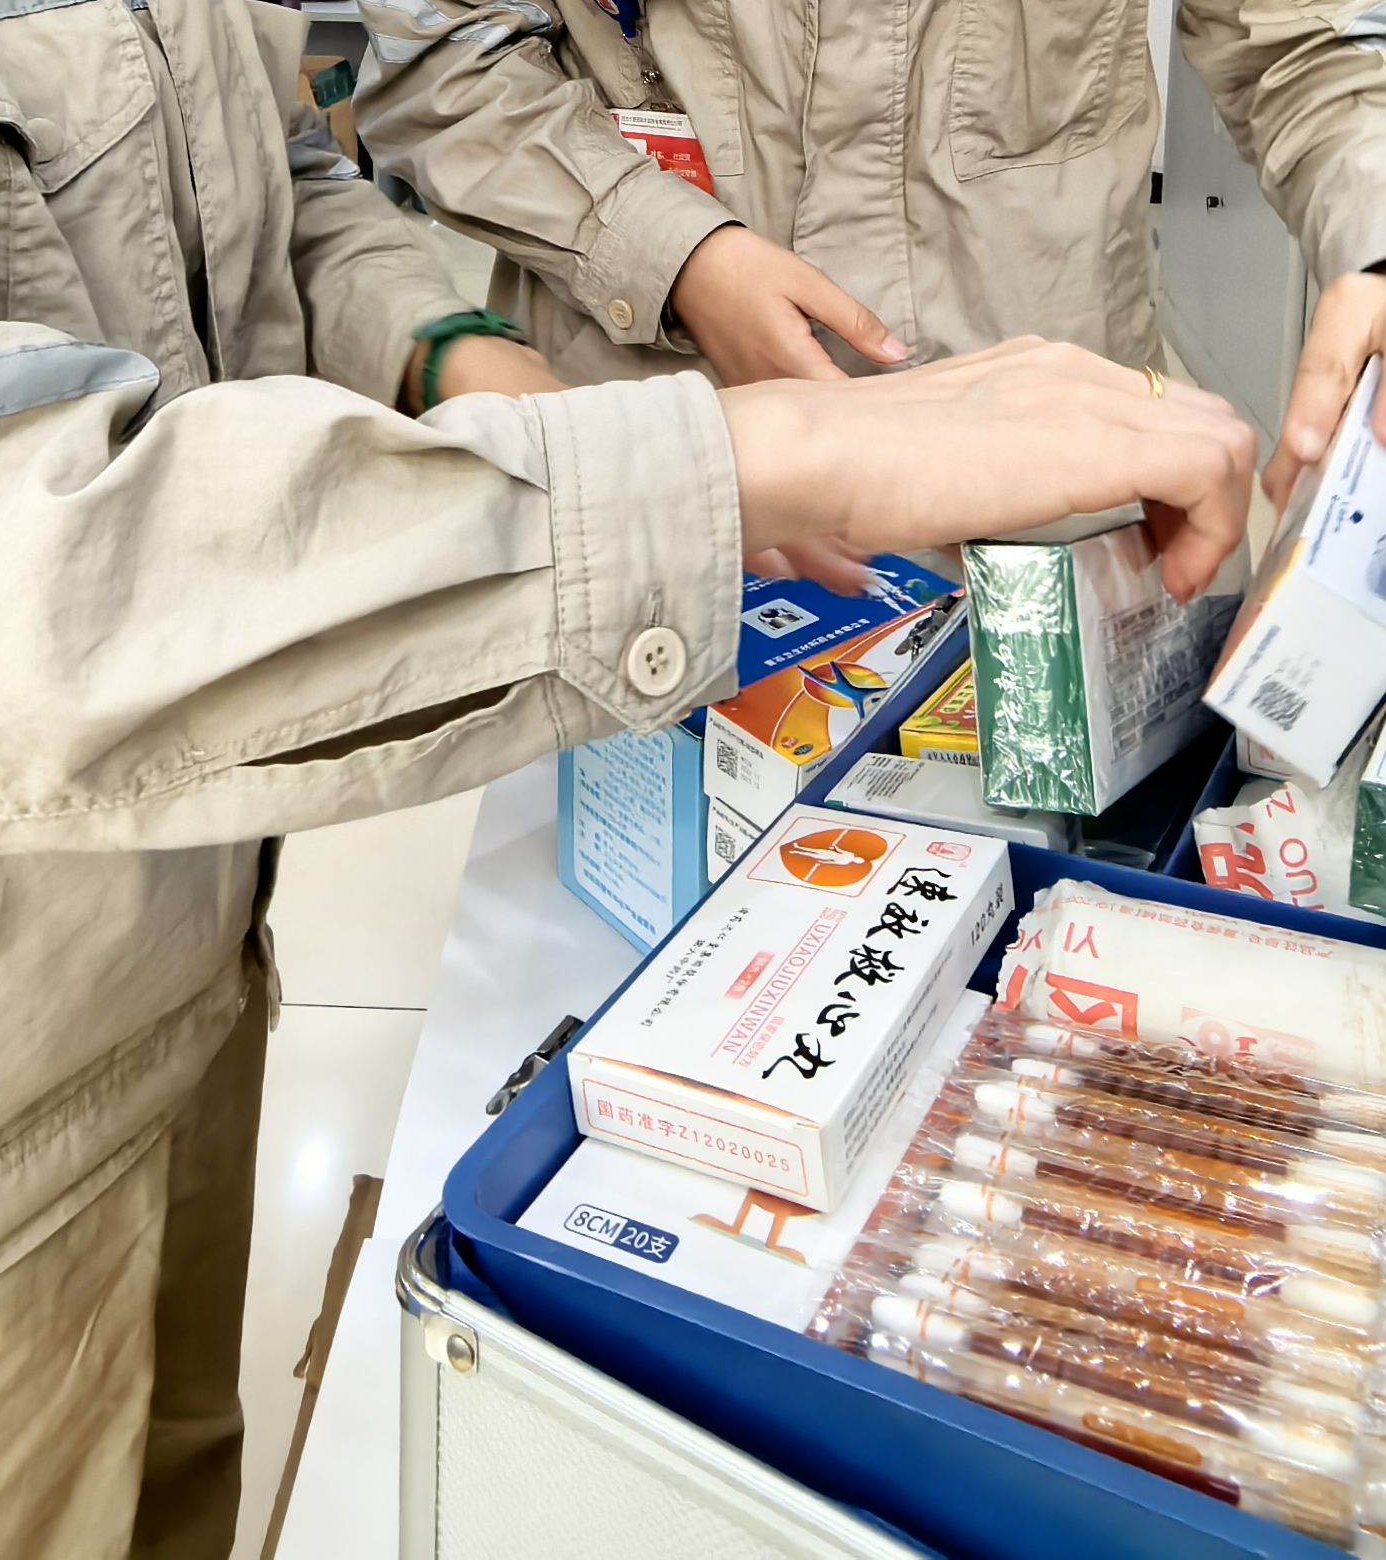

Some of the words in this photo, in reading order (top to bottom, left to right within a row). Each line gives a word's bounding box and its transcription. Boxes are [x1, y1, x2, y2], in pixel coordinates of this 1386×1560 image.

[761, 867, 958, 1080] 速效救心丸
[574, 1211, 620, 1238] 8CM
[620, 1227, 671, 1259] 20支
